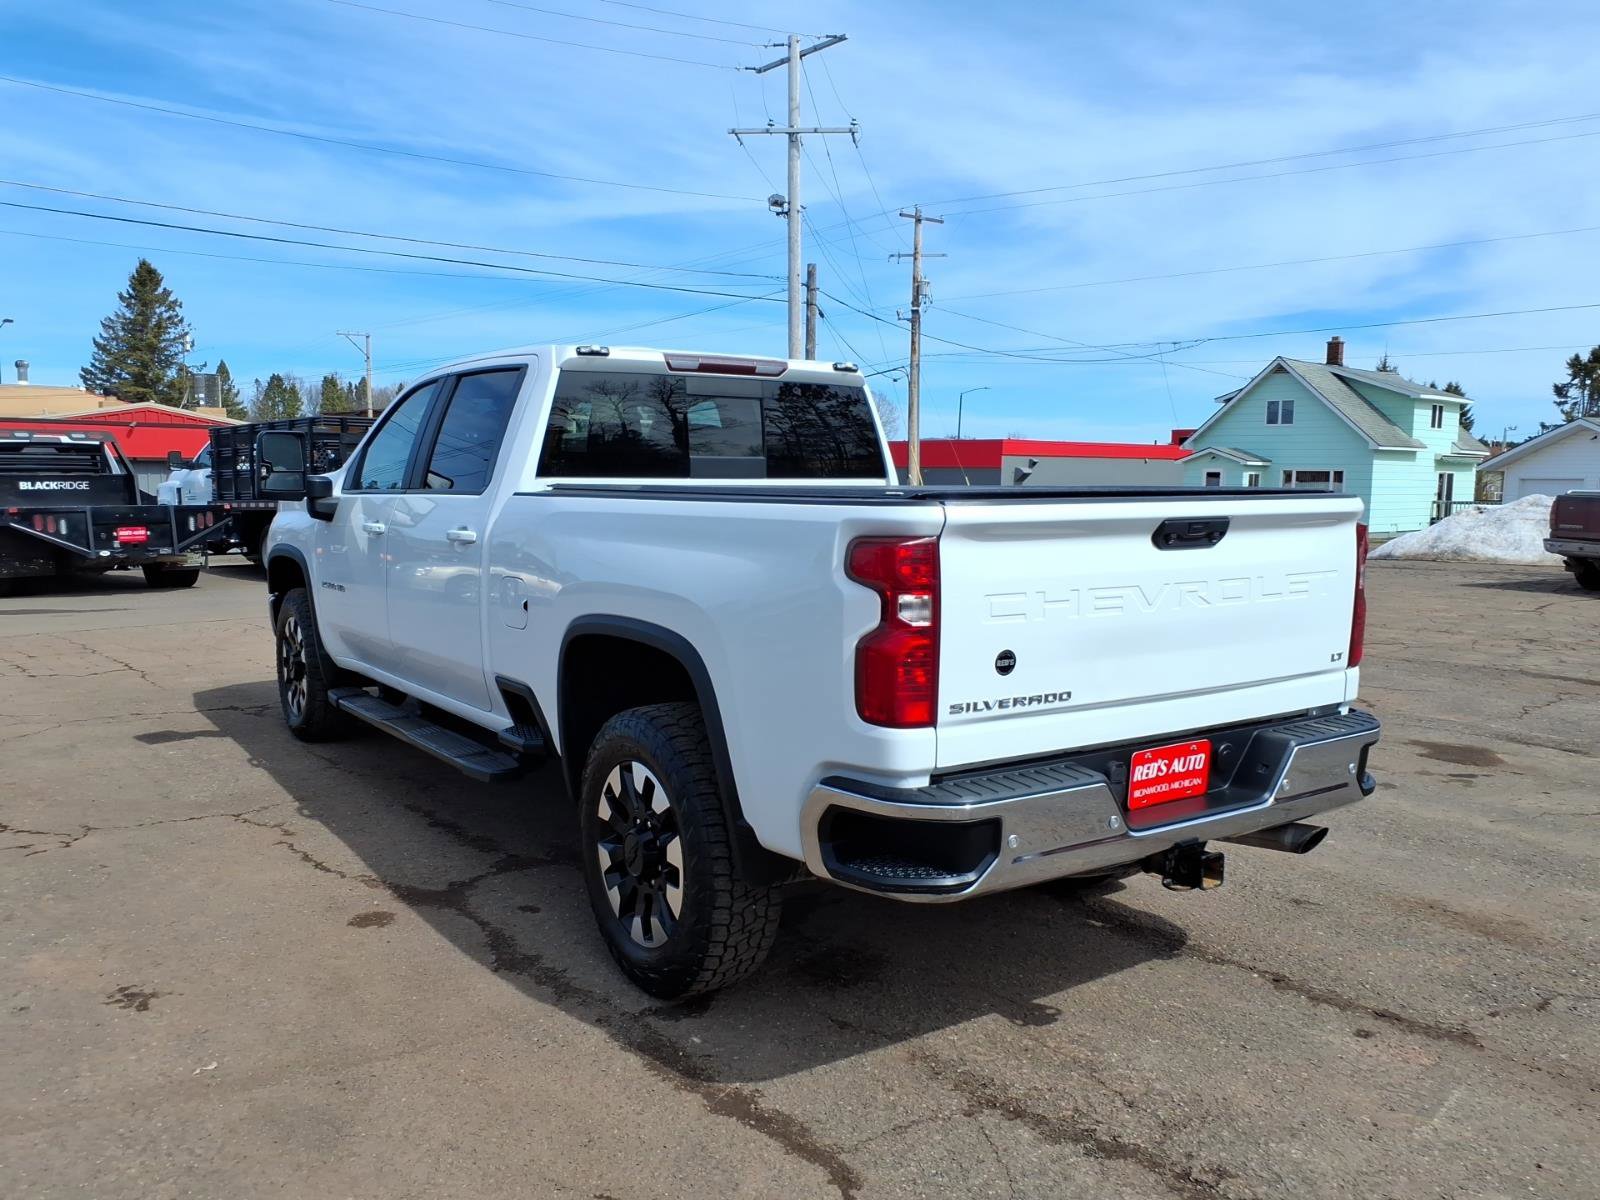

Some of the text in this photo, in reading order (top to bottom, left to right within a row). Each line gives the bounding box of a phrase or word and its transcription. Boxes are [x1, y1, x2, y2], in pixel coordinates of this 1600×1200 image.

[18, 481, 90, 490] BLACKRIDGE
[982, 569, 1338, 624] CHEVROLET
[1330, 652, 1344, 663] LT
[949, 691, 1072, 715] SILVERADO
[1133, 753, 1206, 782] RED'S AUTO
[1170, 777, 1202, 790] MICHIGAN
